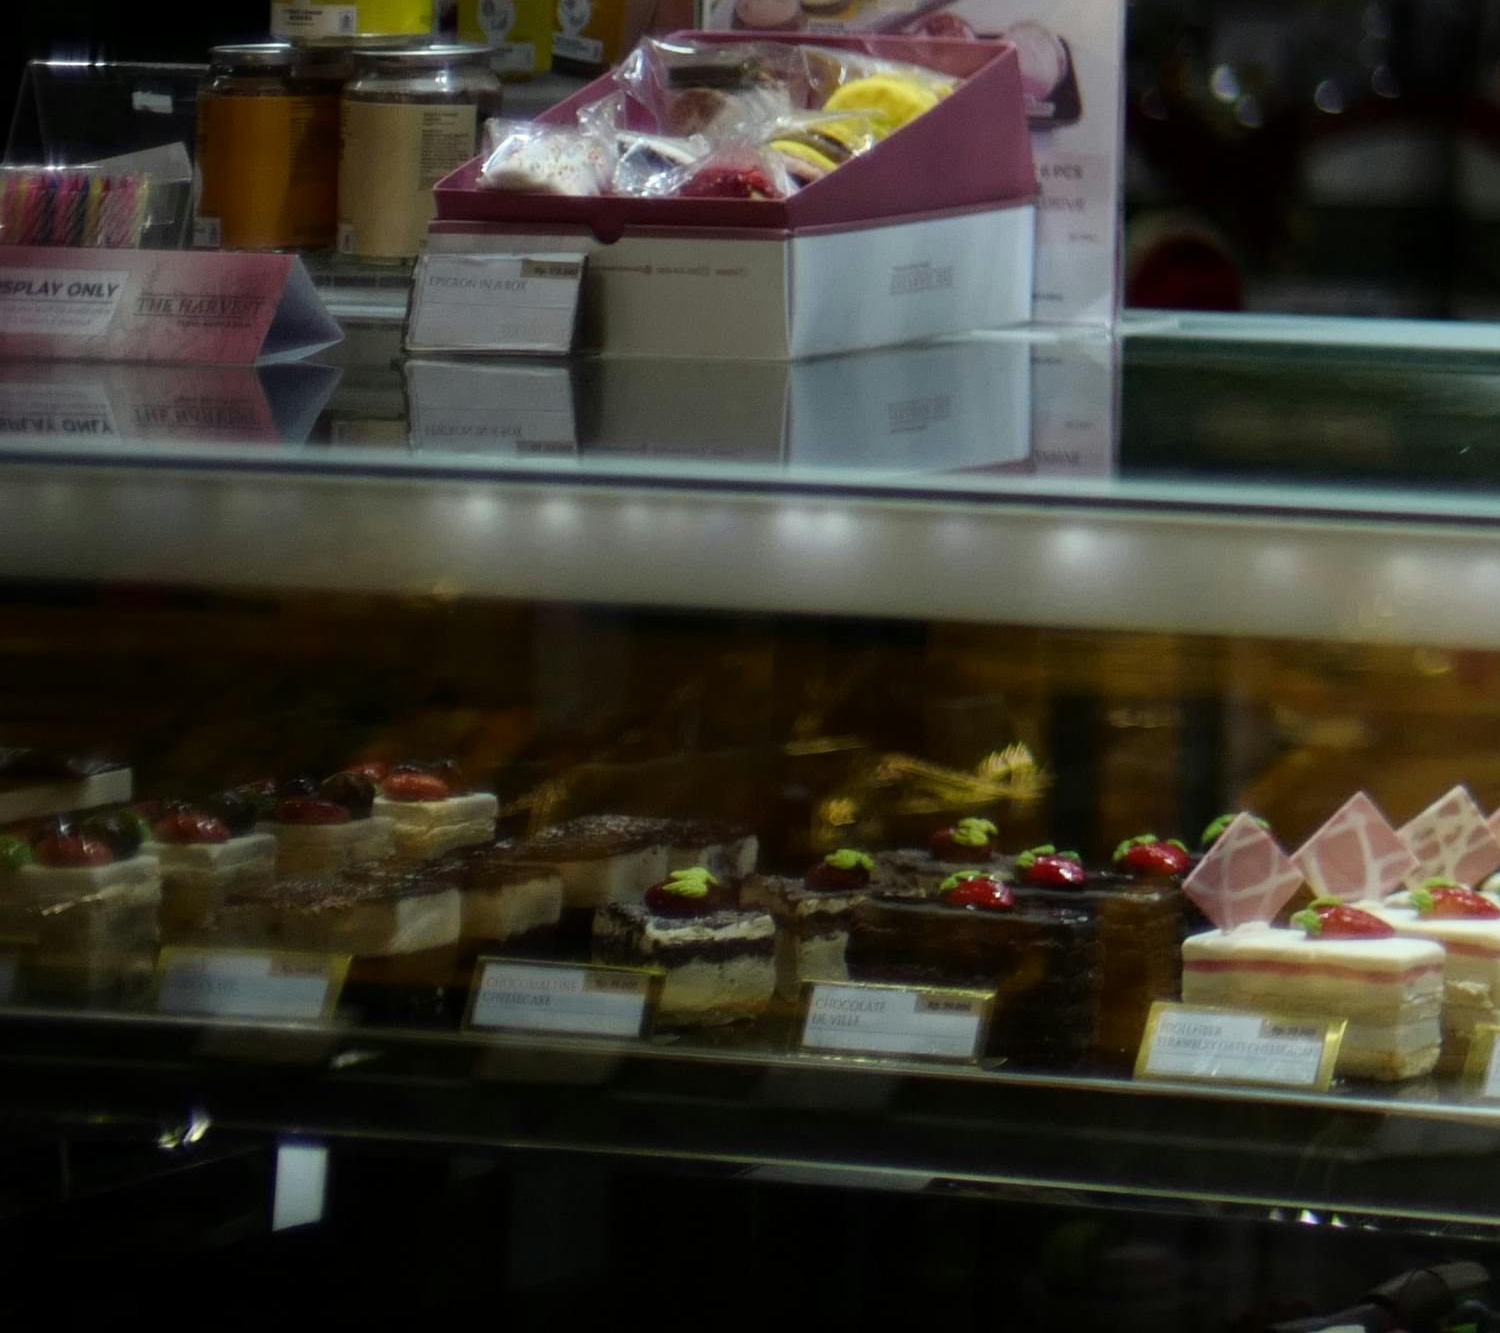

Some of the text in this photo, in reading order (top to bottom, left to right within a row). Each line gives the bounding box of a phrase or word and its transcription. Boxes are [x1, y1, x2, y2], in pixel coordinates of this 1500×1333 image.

[0, 280, 121, 298] SPLAY ONLY
[137, 297, 265, 315] THE HARVEST
[815, 996, 886, 1013] CHOCOLATE
